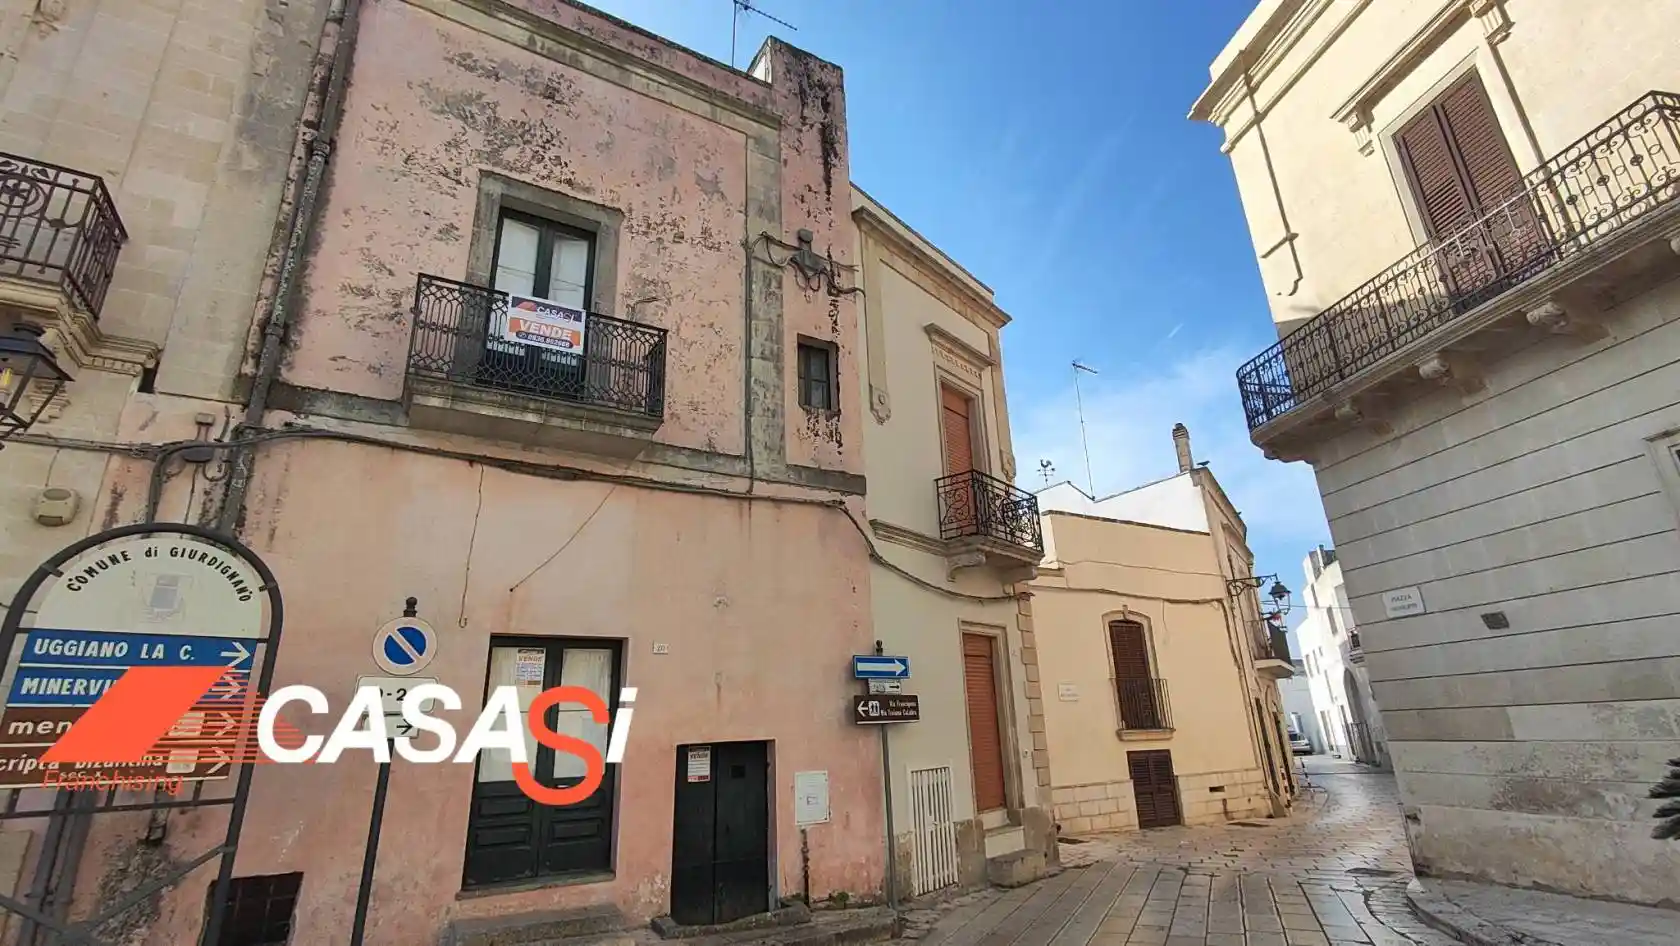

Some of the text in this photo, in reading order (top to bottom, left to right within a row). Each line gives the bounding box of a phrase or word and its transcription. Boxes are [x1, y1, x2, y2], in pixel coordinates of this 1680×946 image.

[519, 319, 573, 340] VENDE
[66, 546, 252, 602] COMUNE di GIURDIGNANO
[34, 638, 195, 661] UGGIANO LA C.
[20, 677, 117, 696] MINERVI
